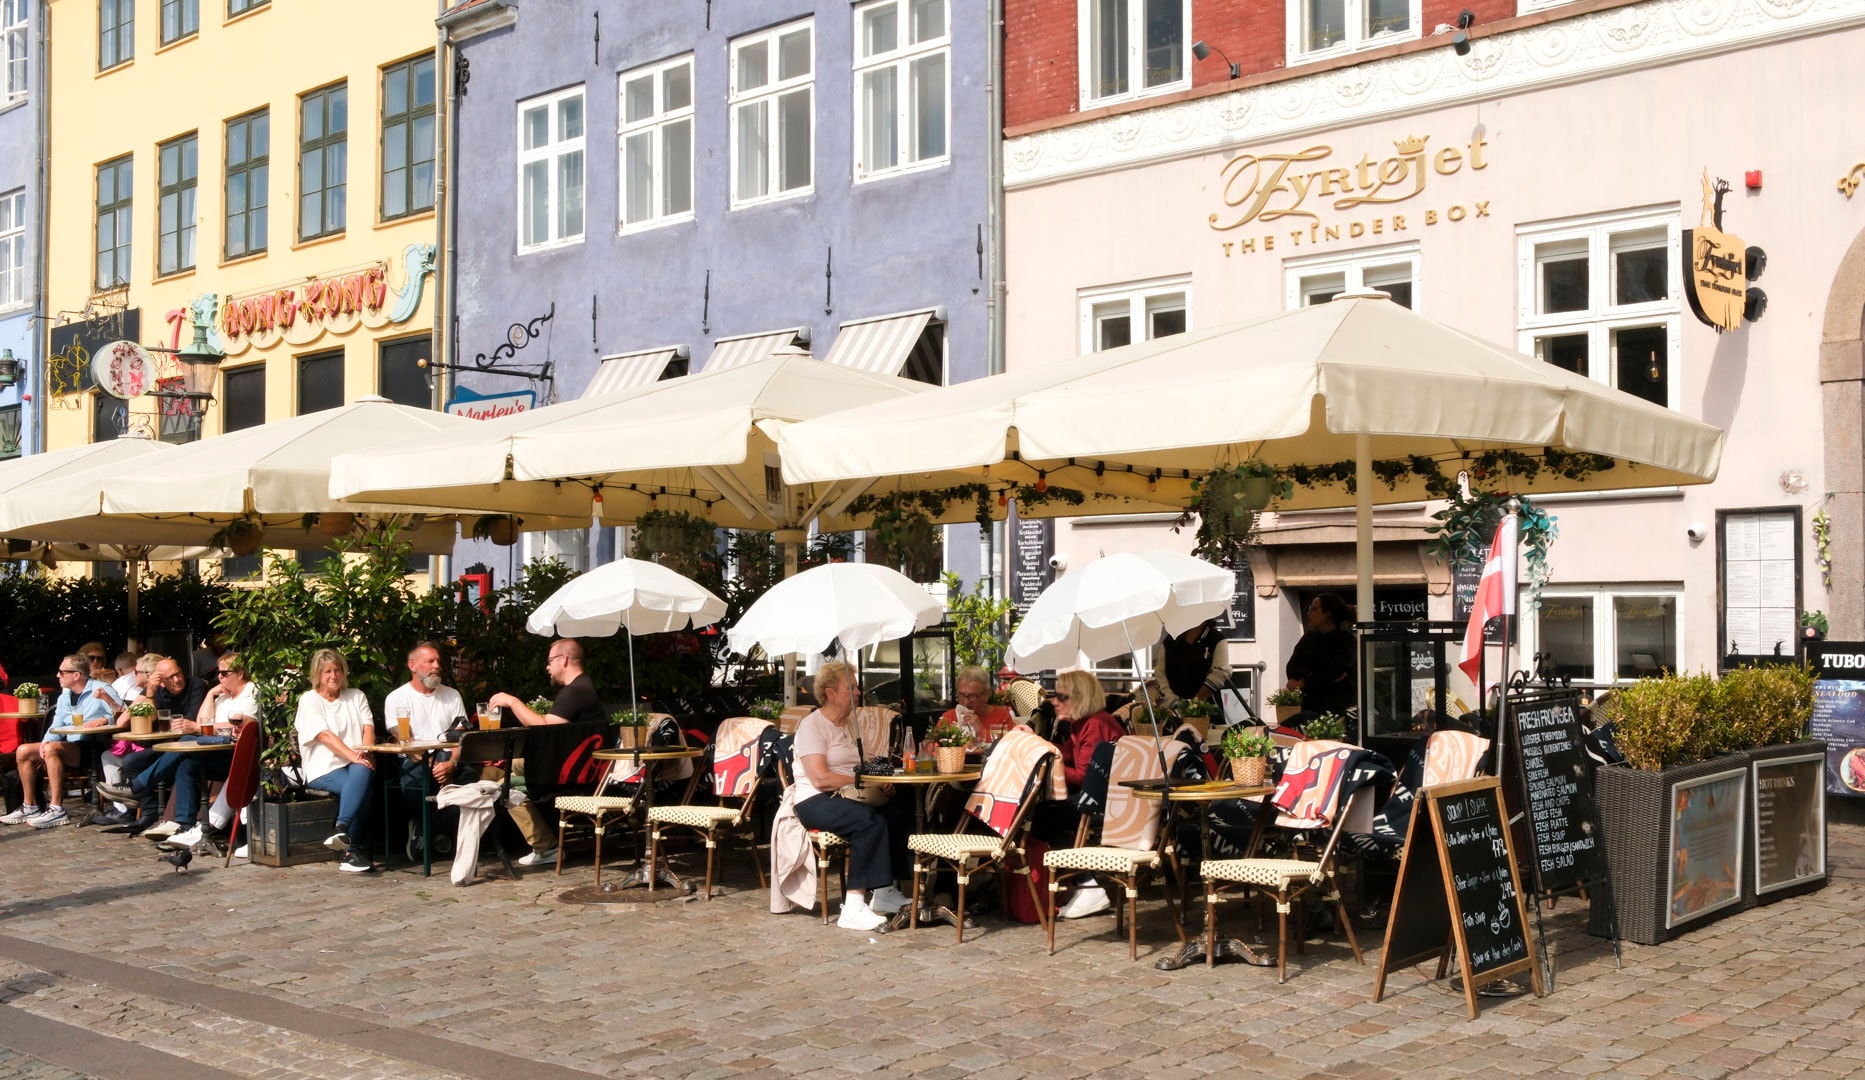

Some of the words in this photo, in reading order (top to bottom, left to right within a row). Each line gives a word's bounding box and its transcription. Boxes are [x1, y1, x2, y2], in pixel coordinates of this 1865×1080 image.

[1209, 132, 1488, 231] Fyrtøjet
[1222, 235, 1275, 258] THE
[1290, 214, 1408, 246] TINDER
[1425, 200, 1491, 226] BOX
[1380, 600, 1425, 615] Fyrtøjet
[1411, 651, 1435, 667] arlsberg
[1821, 653, 1865, 669] TUBO
[1815, 690, 1857, 698] SEAFOOD
[1518, 710, 1541, 731] FRESH
[1559, 705, 1576, 725] SEA
[1556, 782, 1577, 797] SALMON
[1446, 802, 1463, 821] SOUP
[1531, 801, 1545, 812] FISH
[1544, 799, 1556, 808] AND
[1549, 807, 1563, 819] FISH
[1535, 820, 1550, 833] FISH
[1537, 833, 1551, 844] FISH
[1551, 830, 1566, 842] SOUP
[1540, 859, 1555, 872] FISH
[1555, 854, 1575, 869] SALAD
